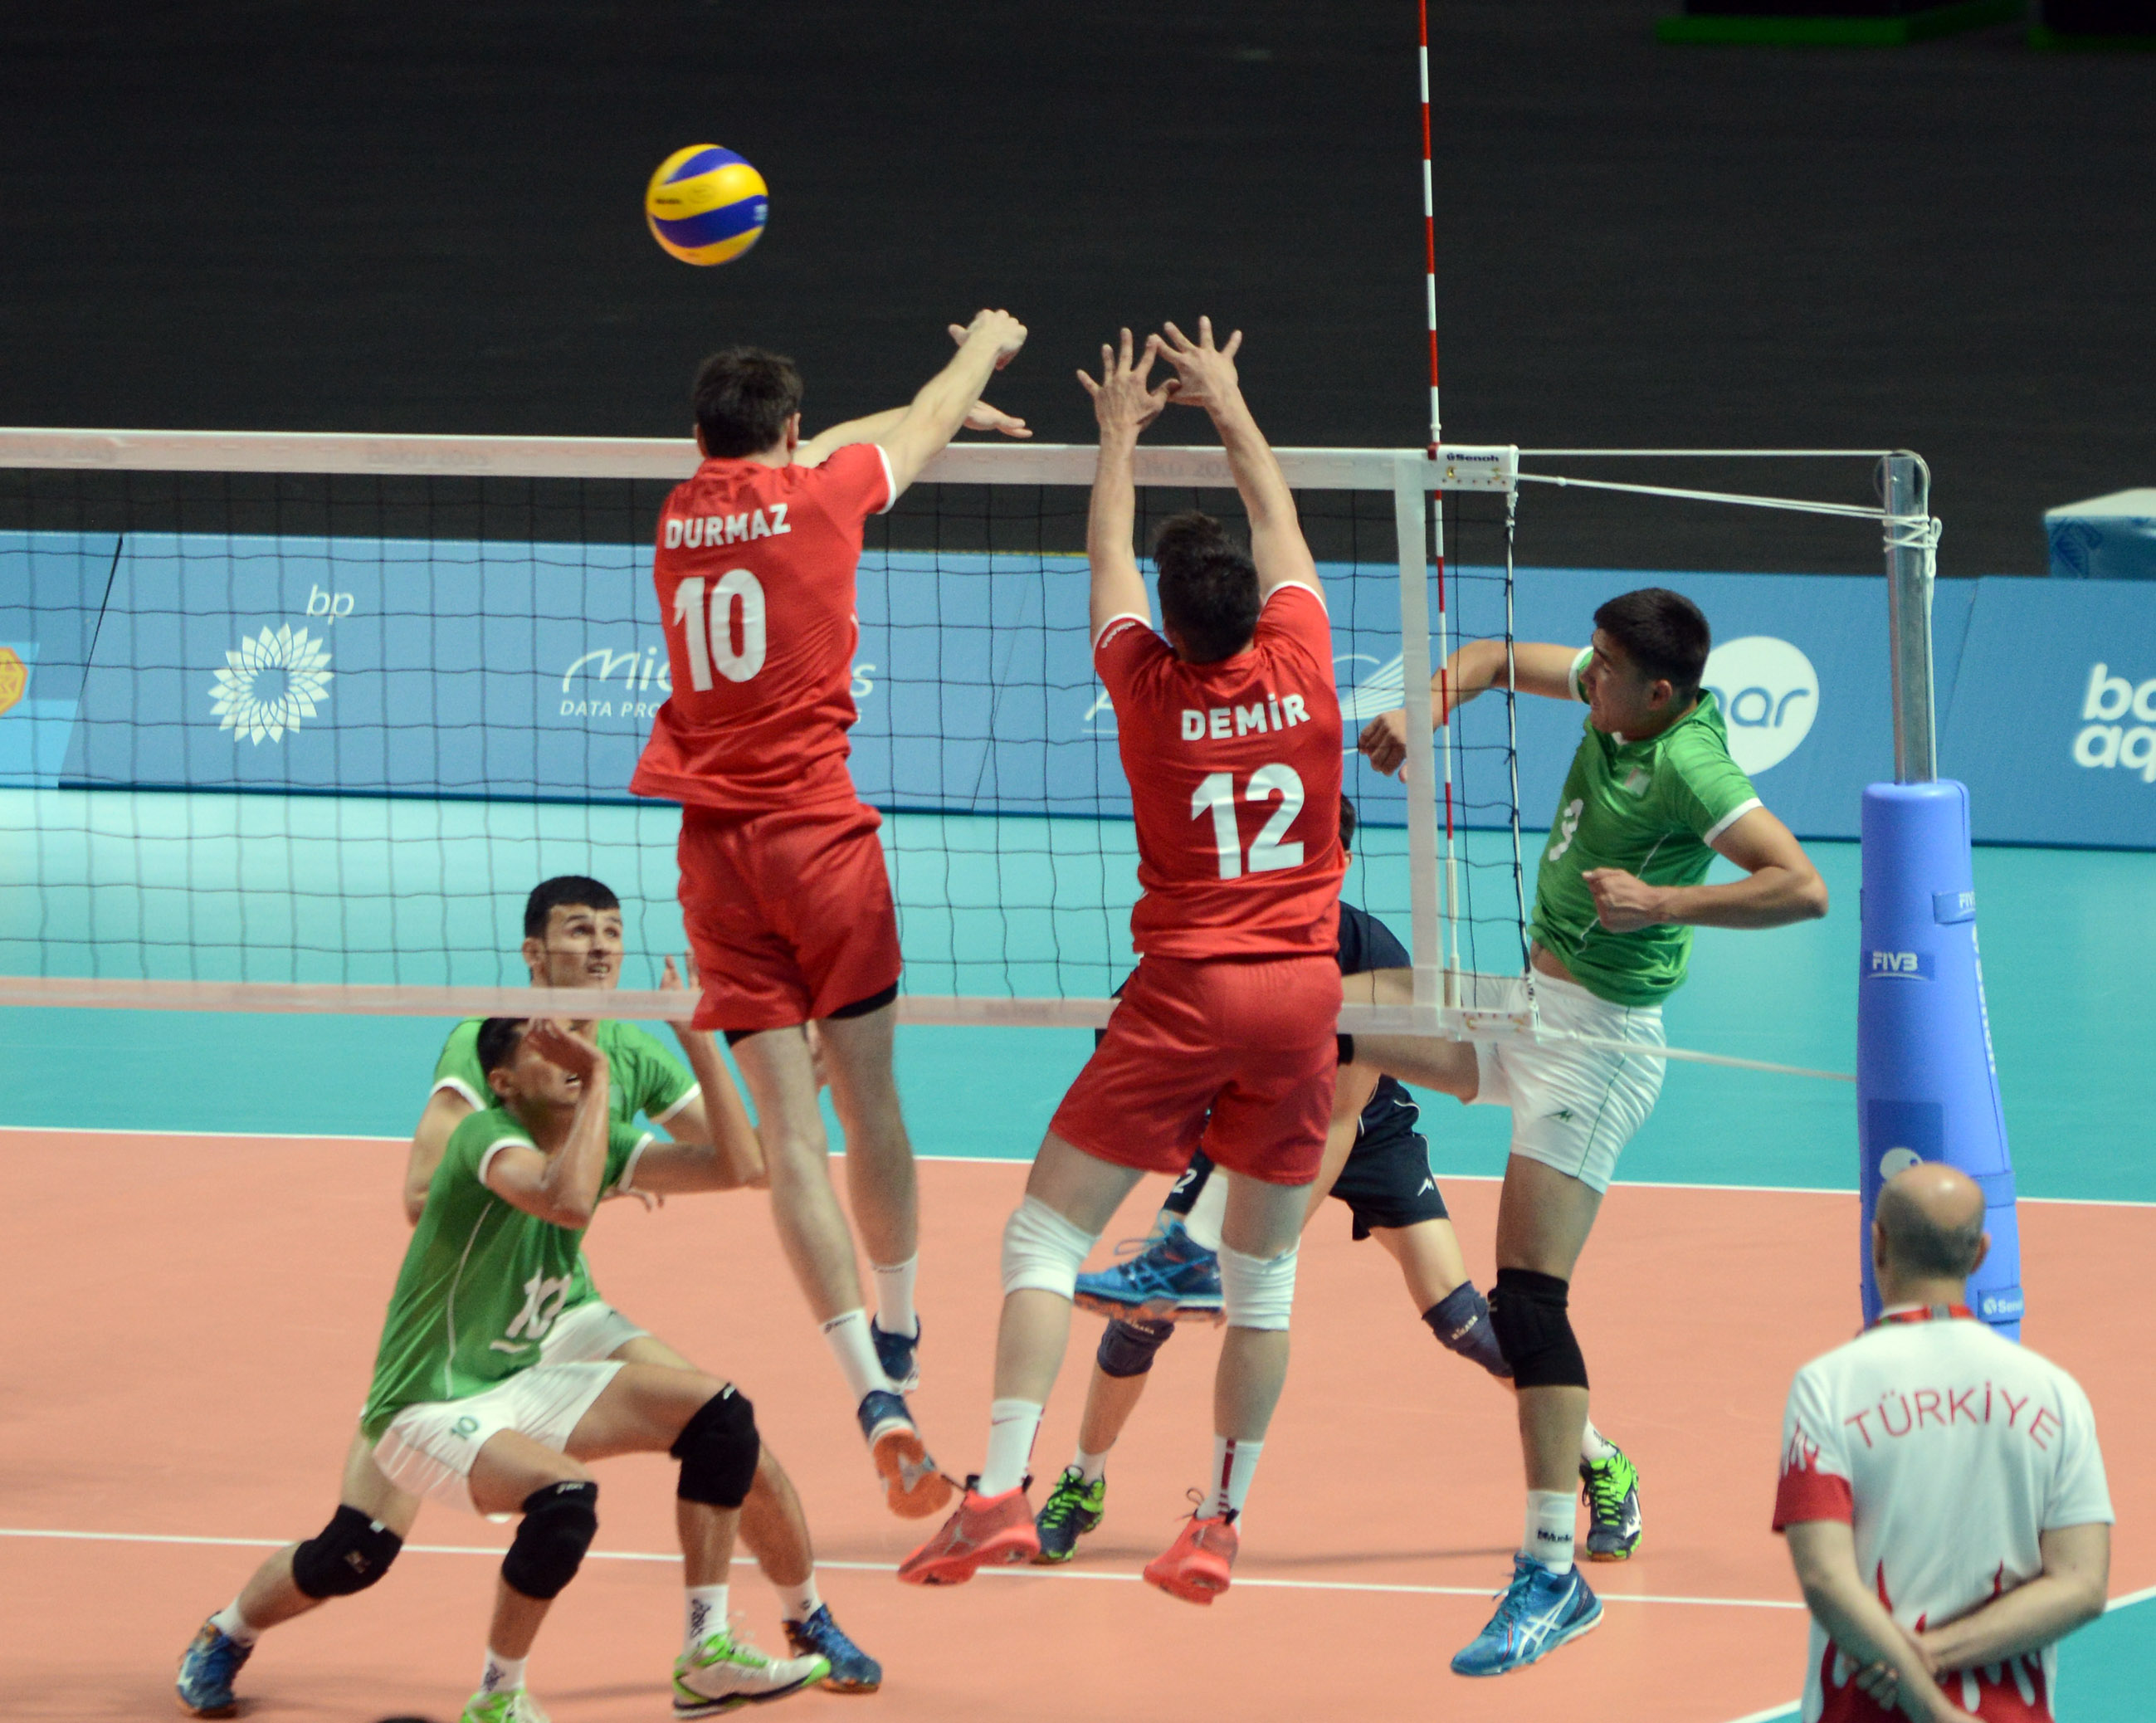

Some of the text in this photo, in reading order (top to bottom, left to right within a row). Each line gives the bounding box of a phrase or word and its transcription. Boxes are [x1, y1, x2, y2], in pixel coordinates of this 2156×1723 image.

[666, 503, 791, 549] DURMAZ
[306, 583, 354, 626] bp
[673, 568, 767, 692] 10
[560, 700, 612, 717] DATA
[1182, 692, 1310, 740] DEMİR
[1192, 762, 1305, 880] 12
[1549, 798, 1583, 862] 3
[505, 1266, 573, 1340] 10
[451, 1415, 480, 1441] 10
[1844, 1380, 2062, 1452] TÜRKİYE
